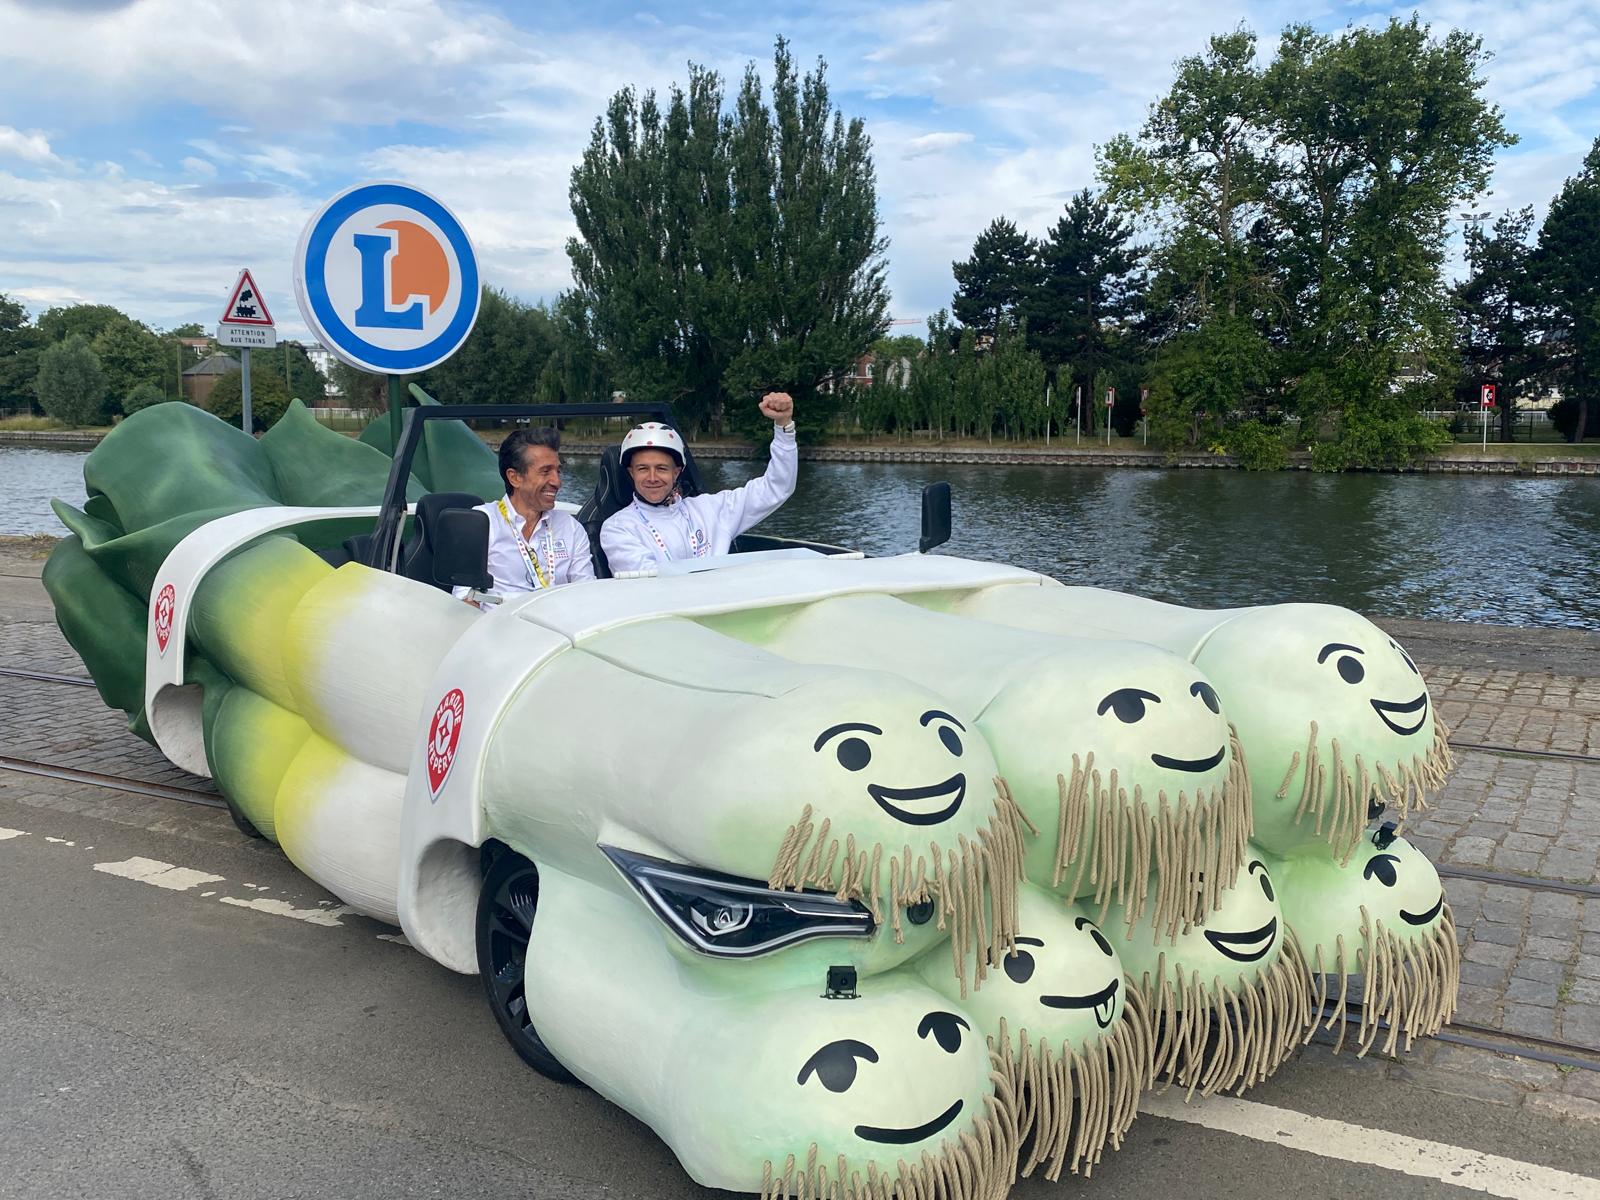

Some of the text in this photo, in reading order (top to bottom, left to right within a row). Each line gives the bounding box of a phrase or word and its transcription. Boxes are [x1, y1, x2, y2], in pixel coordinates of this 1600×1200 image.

[353, 233, 424, 330] L
[230, 329, 266, 337] ATTENTION
[436, 692, 462, 726] MARQUE
